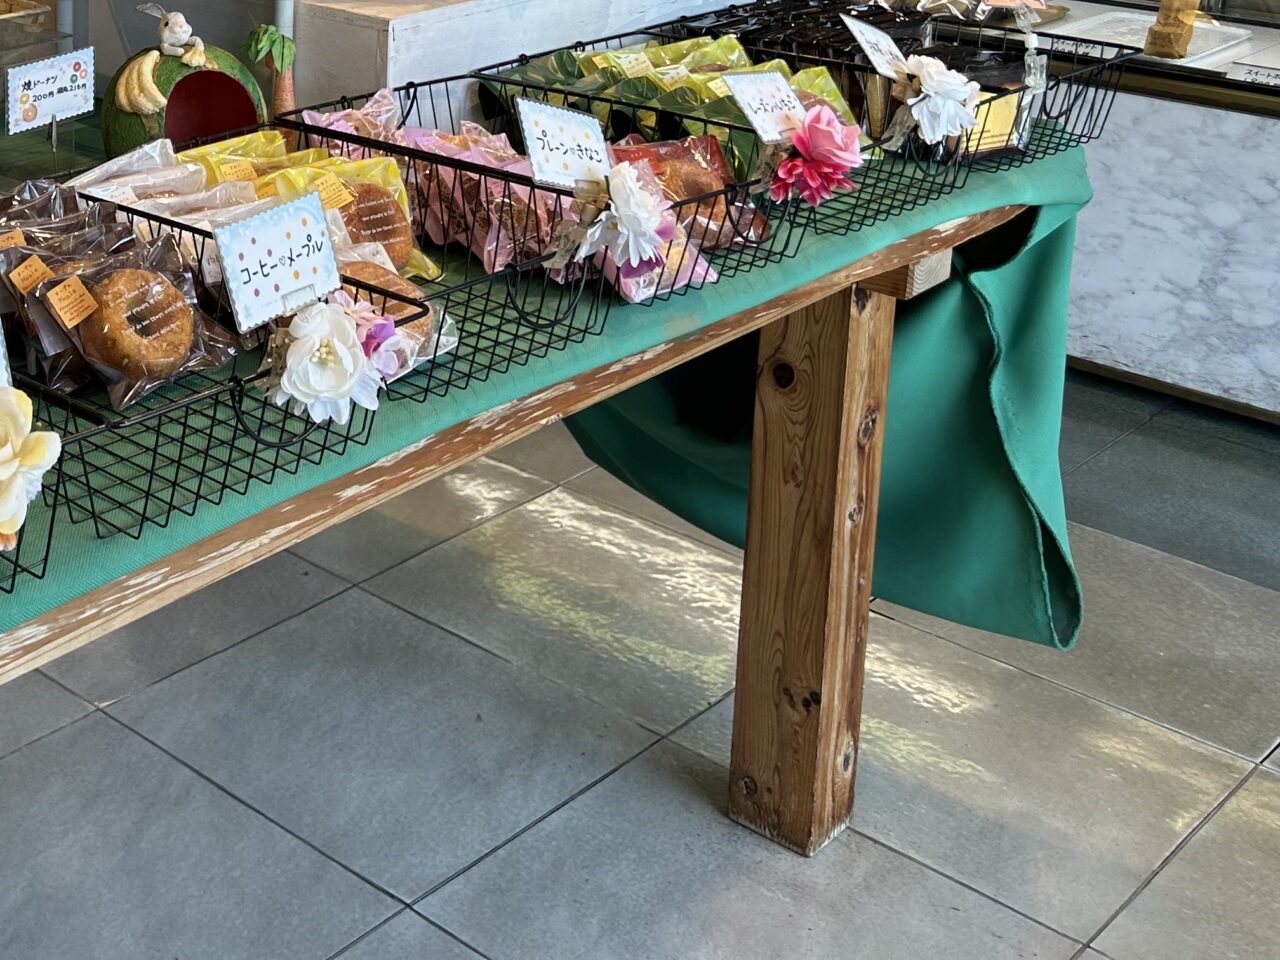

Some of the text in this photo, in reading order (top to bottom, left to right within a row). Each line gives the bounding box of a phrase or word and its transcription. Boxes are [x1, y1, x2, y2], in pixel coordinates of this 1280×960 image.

[21, 75, 58, 93] 焼ドーナツ
[32, 90, 55, 103] 200円
[536, 129, 602, 163] プレーン きなこ
[240, 259, 279, 285] コーヒー
[287, 233, 324, 267] メープル
